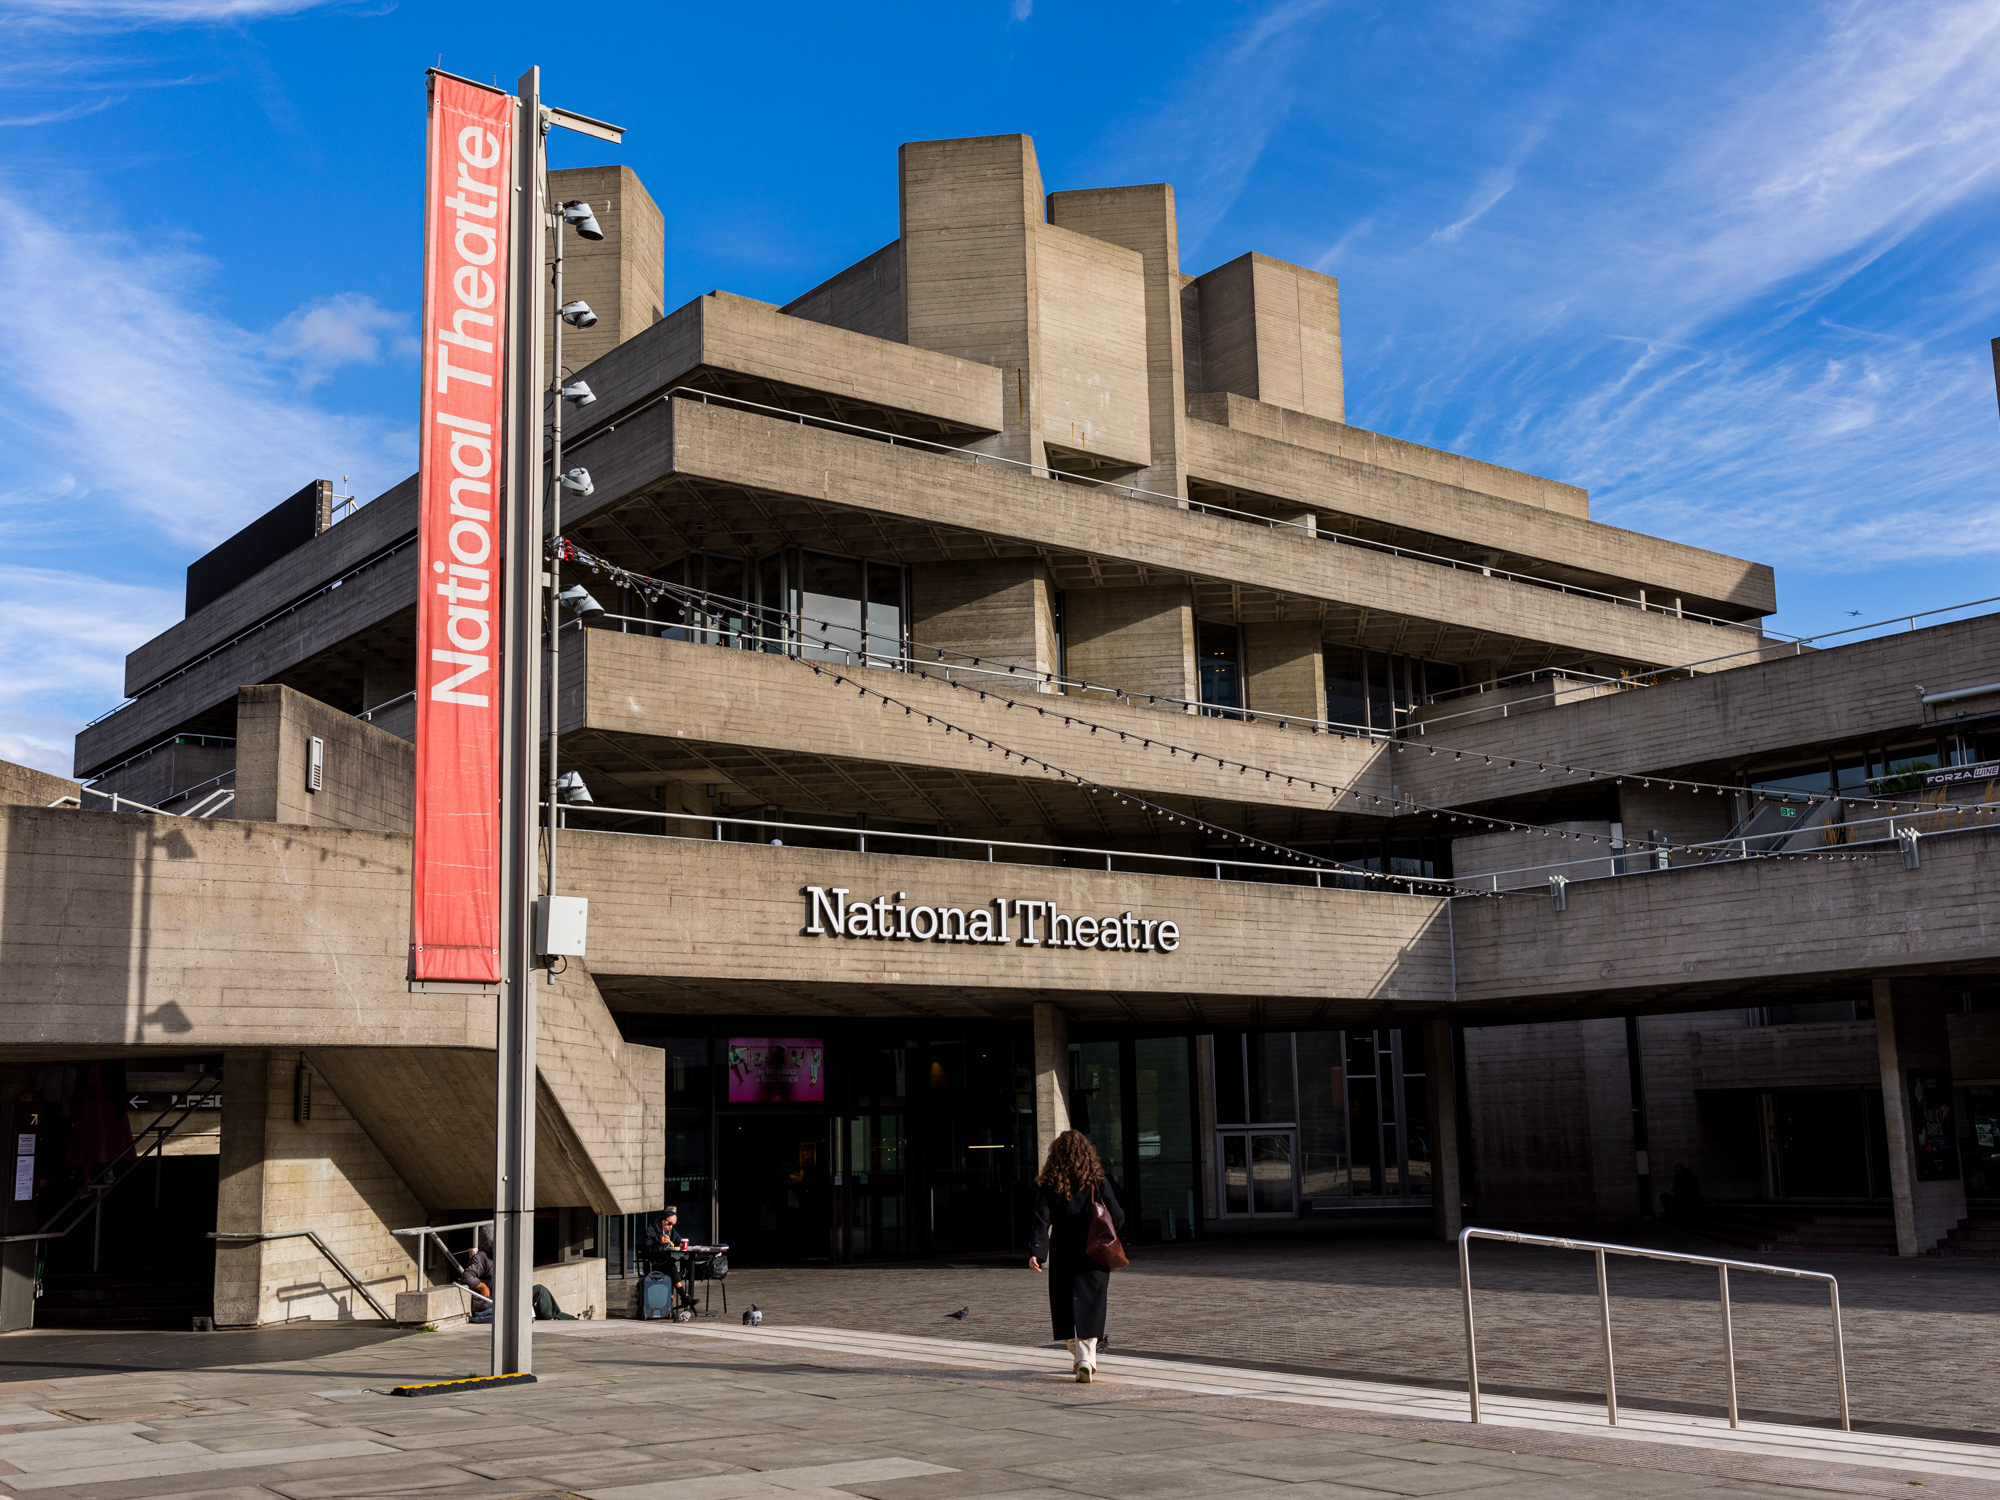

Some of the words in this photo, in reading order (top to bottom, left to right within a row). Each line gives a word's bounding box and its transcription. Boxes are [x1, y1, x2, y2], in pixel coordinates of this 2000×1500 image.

[438, 126, 501, 396] Theatre
[431, 418, 492, 707] National
[1927, 772, 1972, 783] FORZA
[1975, 766, 1998, 777] WINE
[805, 886, 1011, 943] National
[1015, 898, 1180, 951] Theatre
